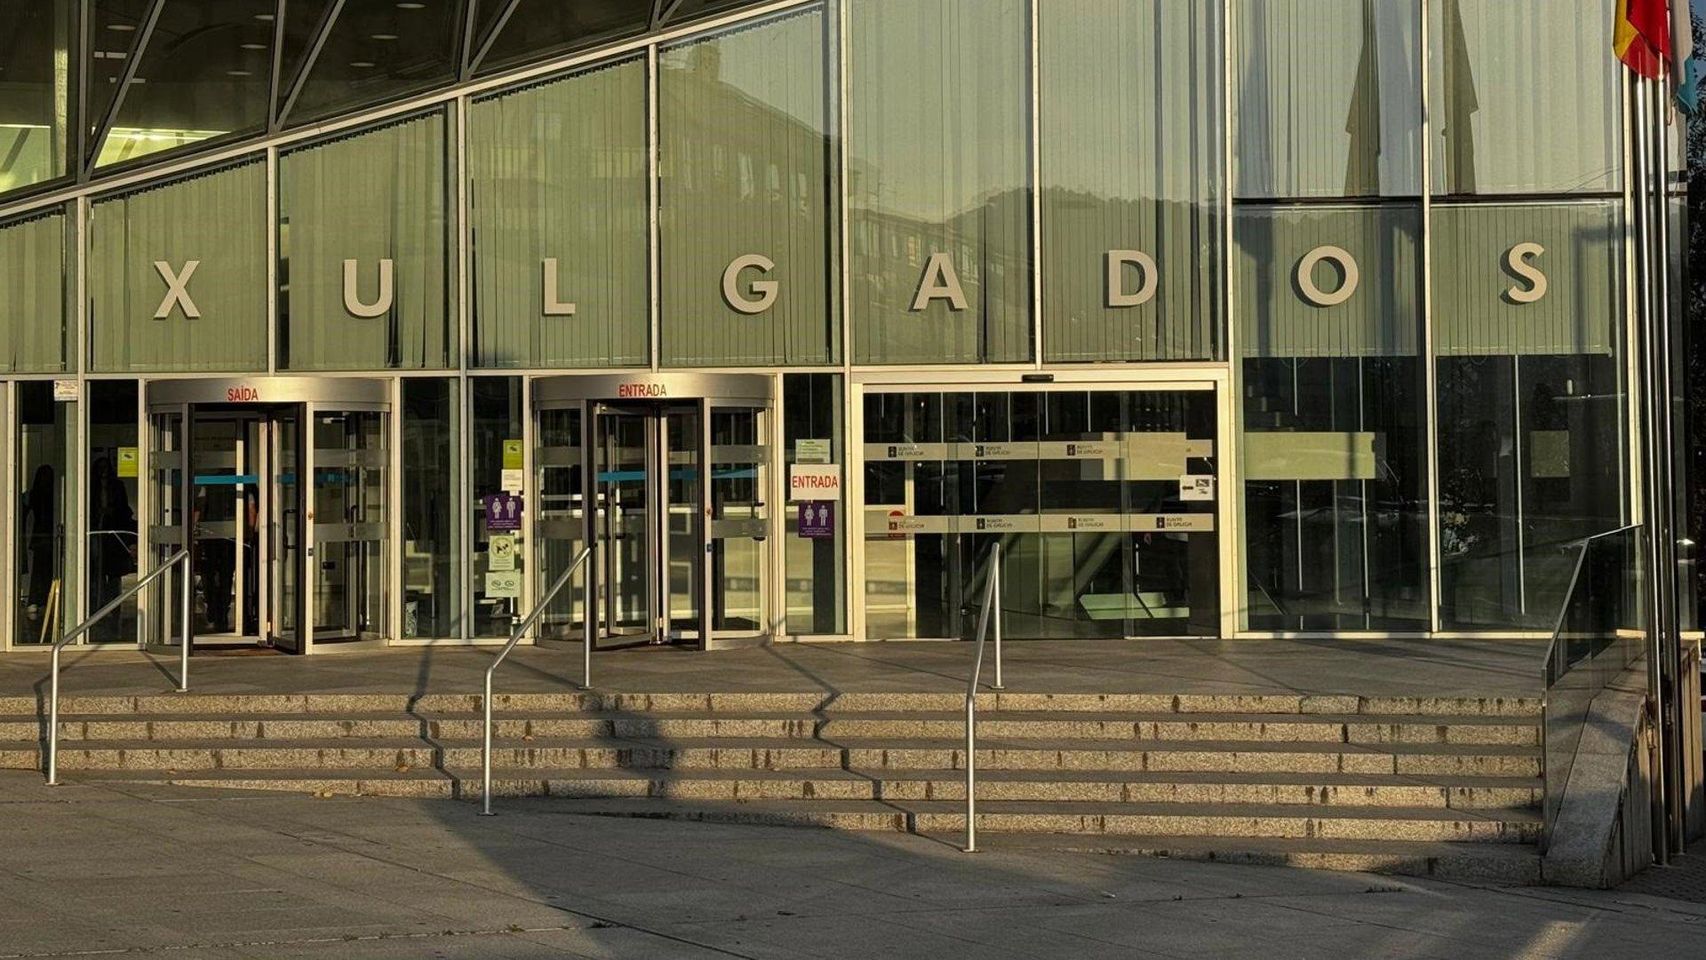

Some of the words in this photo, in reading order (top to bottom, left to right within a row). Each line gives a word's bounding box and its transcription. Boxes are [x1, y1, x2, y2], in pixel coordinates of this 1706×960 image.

[153, 242, 1547, 319] XULGADOS
[227, 385, 258, 401] SAÍDA
[618, 383, 667, 398] ENTRADA
[791, 475, 839, 489] ENTRADA
